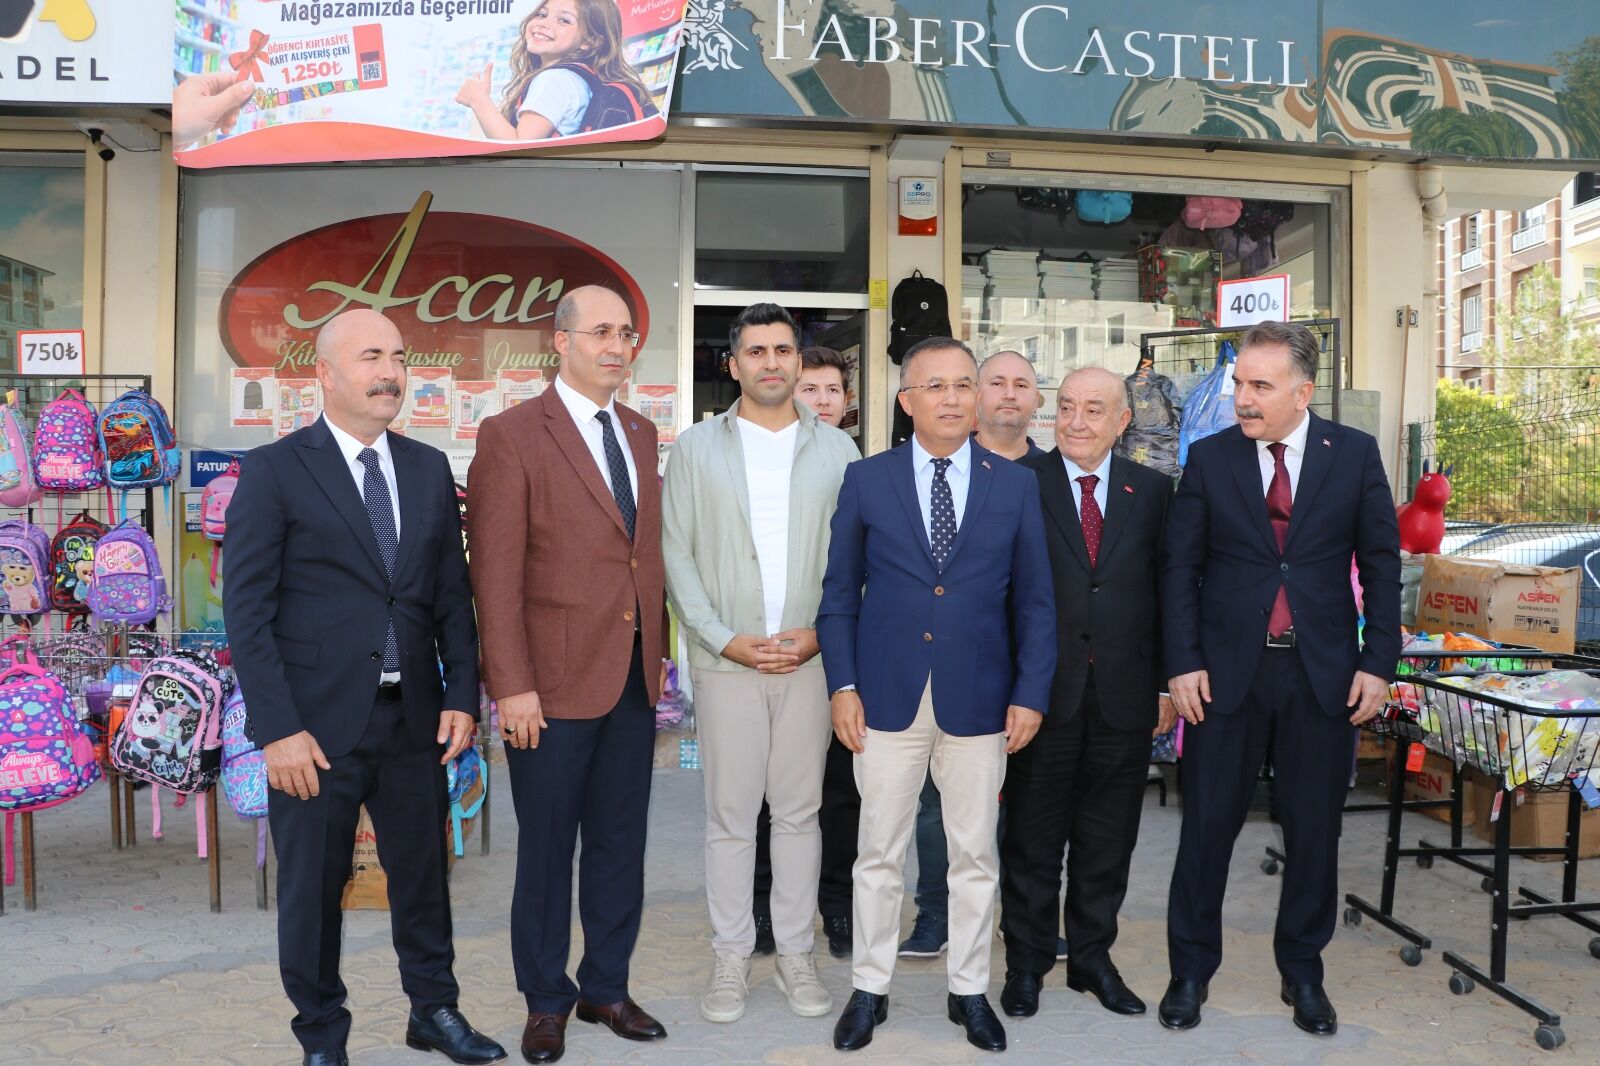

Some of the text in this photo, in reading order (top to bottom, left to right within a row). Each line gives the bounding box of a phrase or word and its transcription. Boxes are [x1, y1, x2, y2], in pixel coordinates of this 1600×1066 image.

[0, 55, 109, 81] DEL
[269, 54, 288, 66] KART
[283, 190, 564, 330] Acar
[25, 341, 79, 362] 750₺
[165, 681, 177, 689] SO
[225, 708, 246, 730] GIRL
